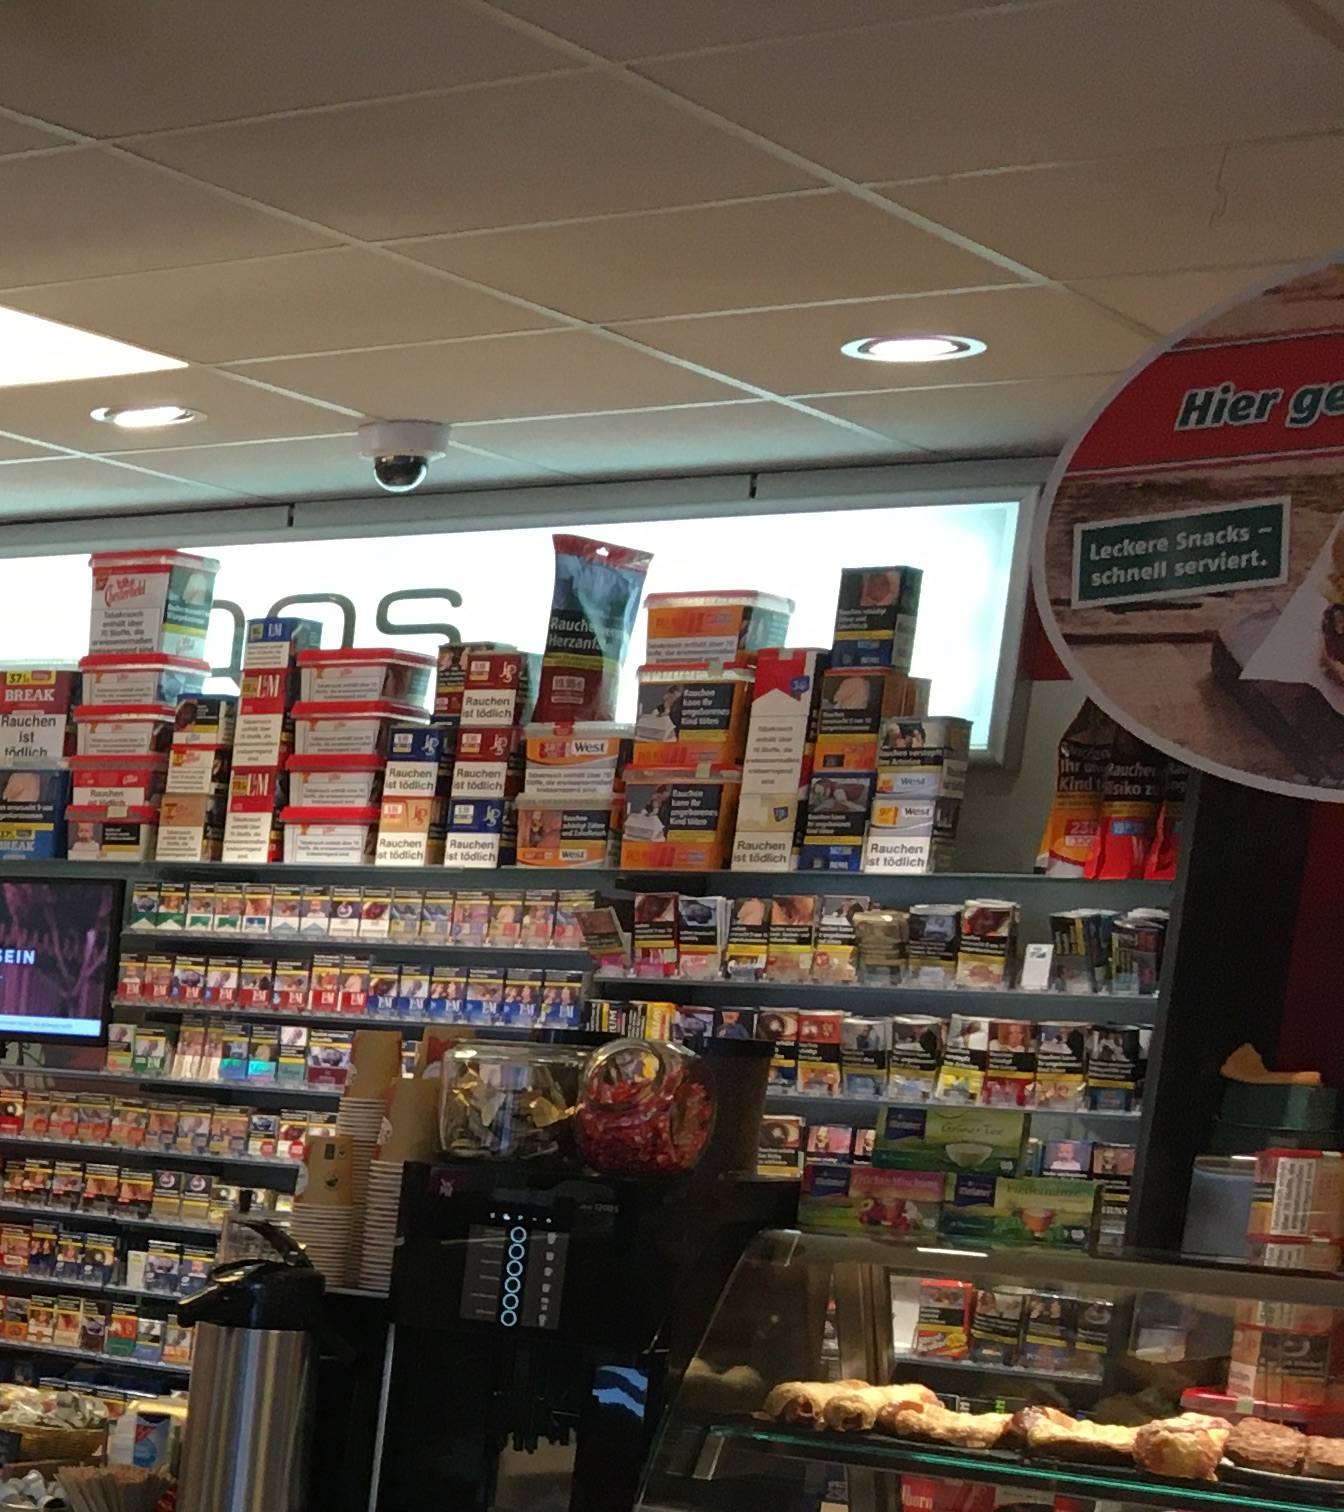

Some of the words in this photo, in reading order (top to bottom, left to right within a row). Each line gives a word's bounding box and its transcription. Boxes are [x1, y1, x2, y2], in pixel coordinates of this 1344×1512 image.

[1176, 384, 1282, 431] Hier
[1090, 535, 1168, 561] Leckere
[1177, 526, 1250, 550] Snacks
[1092, 563, 1165, 587] schnell
[1174, 550, 1268, 577] serviert.
[5, 689, 55, 702] BREAK
[465, 697, 511, 708] Rauchen
[476, 709, 512, 719] tödlich
[1, 715, 57, 729] Rauchen
[19, 730, 35, 743] ist
[574, 742, 606, 753] West
[390, 769, 433, 779] Rauchen
[456, 769, 501, 779] Rauchen
[399, 780, 434, 790] tödlich
[466, 780, 502, 790] tödlich
[900, 777, 926, 786] West
[904, 807, 930, 816] West
[379, 838, 422, 849] Rauchen
[449, 840, 494, 850] Rauchen
[737, 841, 786, 852] Rauchen
[562, 850, 586, 860] West
[871, 844, 924, 855] Rauchen
[388, 850, 424, 861] tödlich
[459, 851, 496, 861] tödlich
[748, 853, 787, 864] tödlich
[881, 856, 925, 868] tödlich
